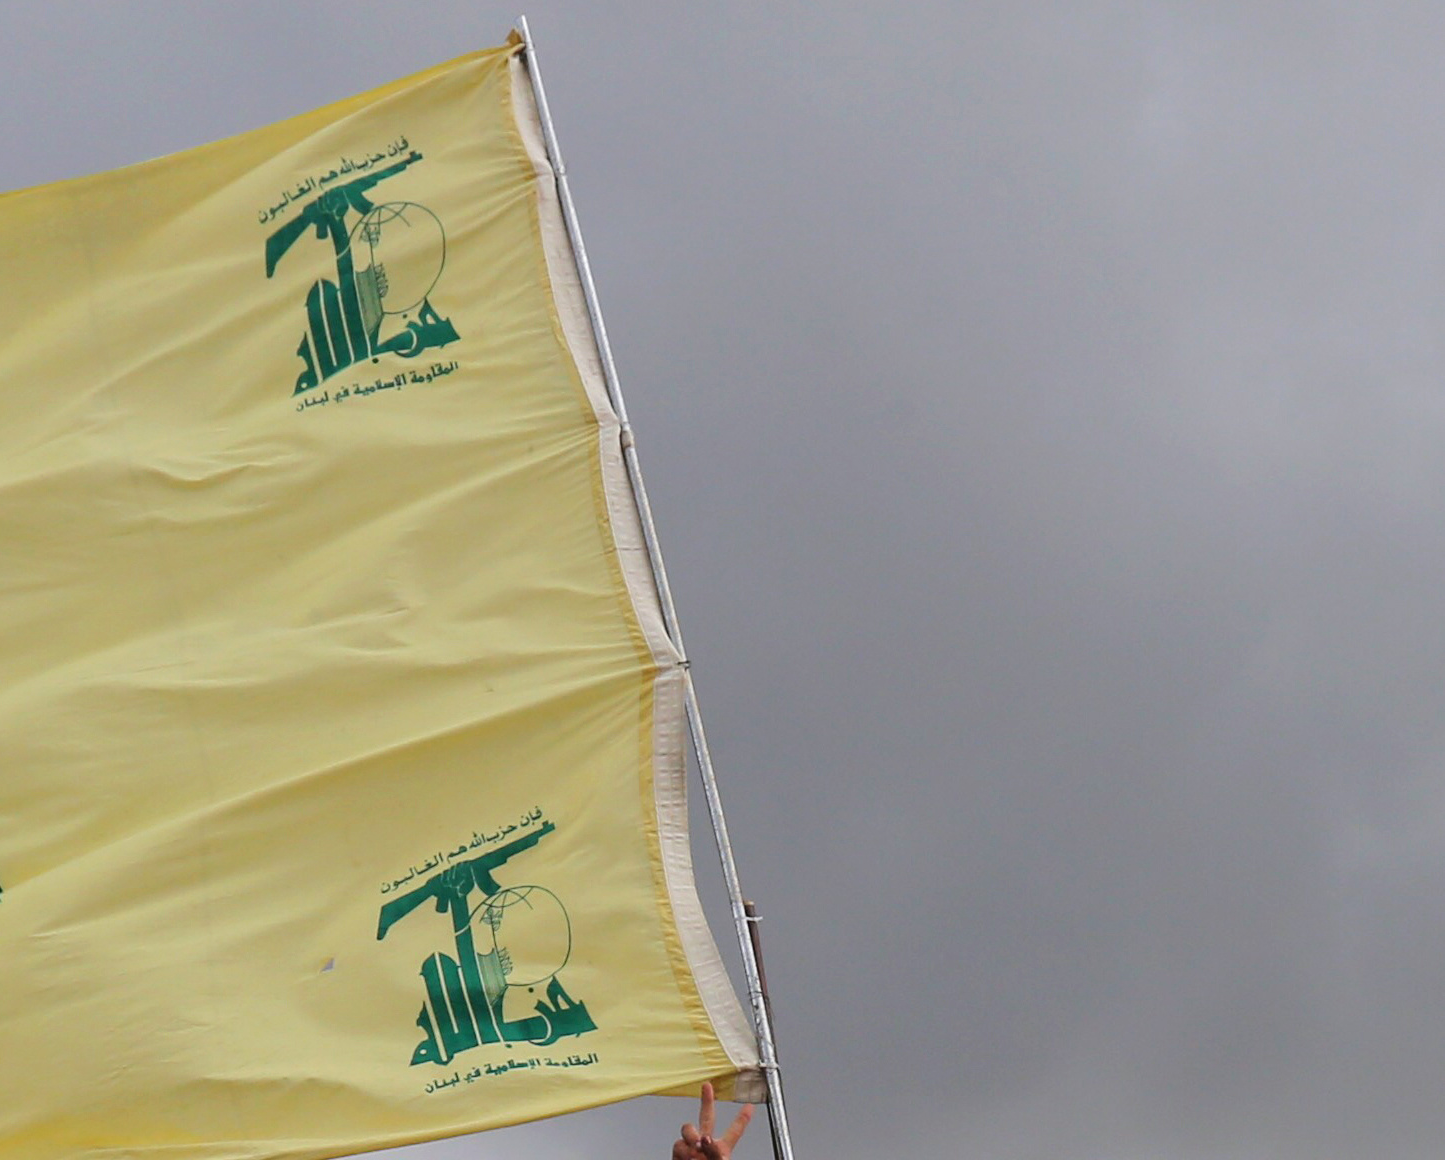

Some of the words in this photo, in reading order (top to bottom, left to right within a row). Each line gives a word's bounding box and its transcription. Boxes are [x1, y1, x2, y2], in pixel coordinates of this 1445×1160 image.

[318, 170, 339, 189] هم
[410, 361, 459, 384] المقاومة
[296, 391, 329, 412] لبنان
[333, 387, 351, 403] في
[446, 845, 468, 864] هم
[424, 1073, 461, 1094] لبنان
[463, 1067, 481, 1083] في
